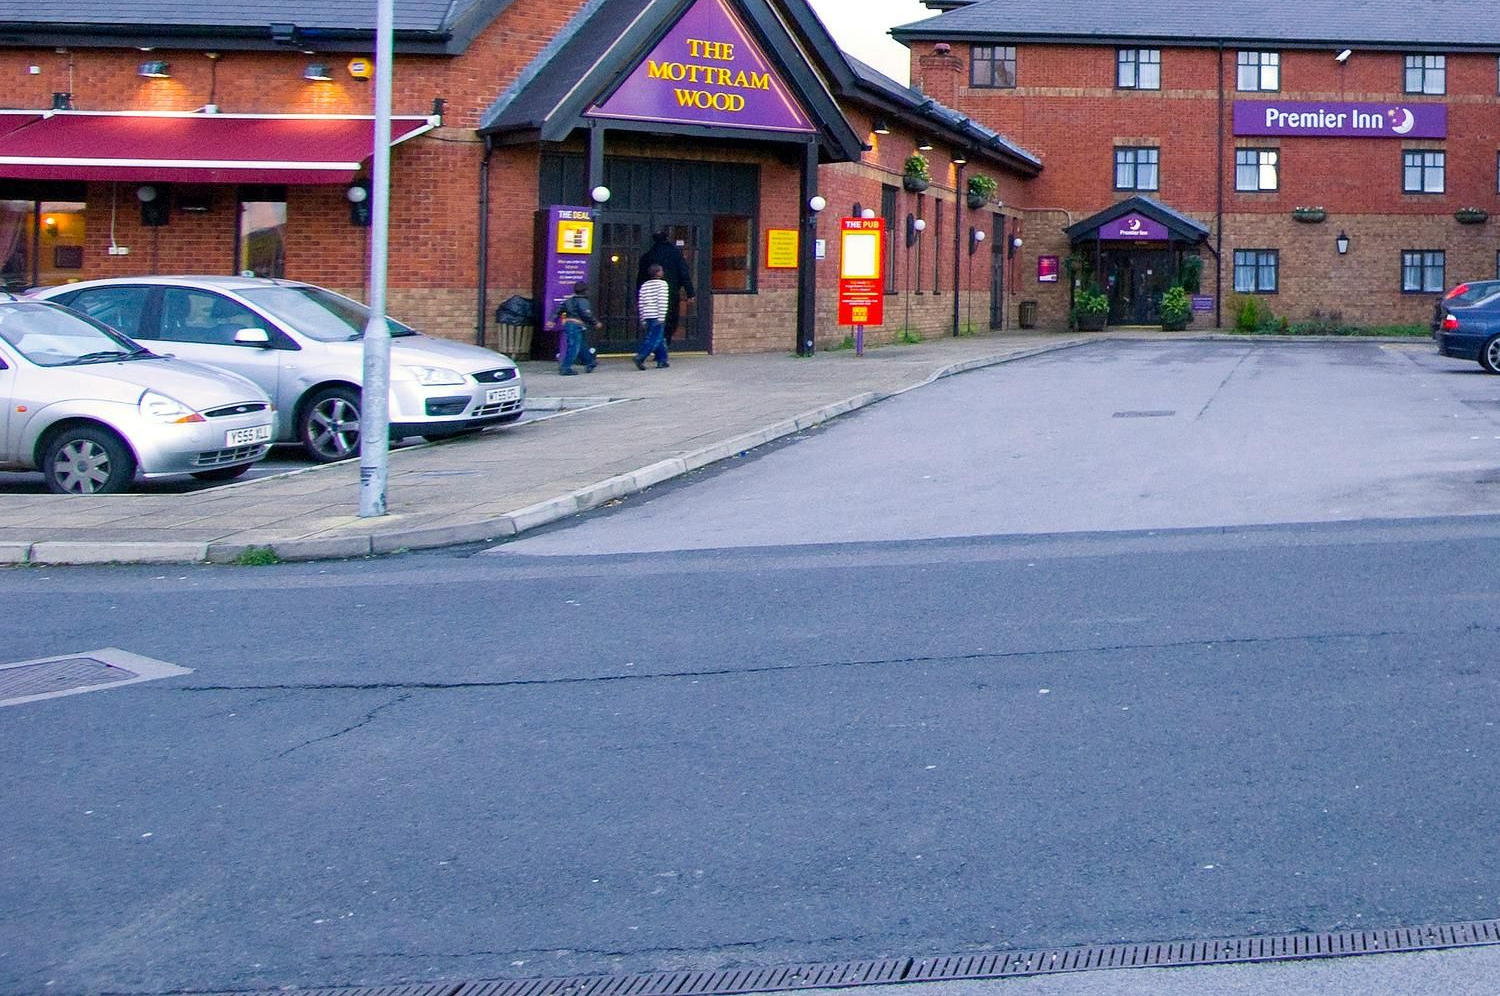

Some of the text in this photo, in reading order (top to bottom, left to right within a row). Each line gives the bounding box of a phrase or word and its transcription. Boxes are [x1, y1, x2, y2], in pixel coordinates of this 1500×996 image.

[686, 38, 735, 61] THE
[648, 60, 770, 91] MOTTRAM
[674, 88, 745, 112] WOOD
[1265, 108, 1384, 129] Premier Inn
[558, 210, 591, 220] THE DEAL
[845, 220, 880, 229] THE PUB
